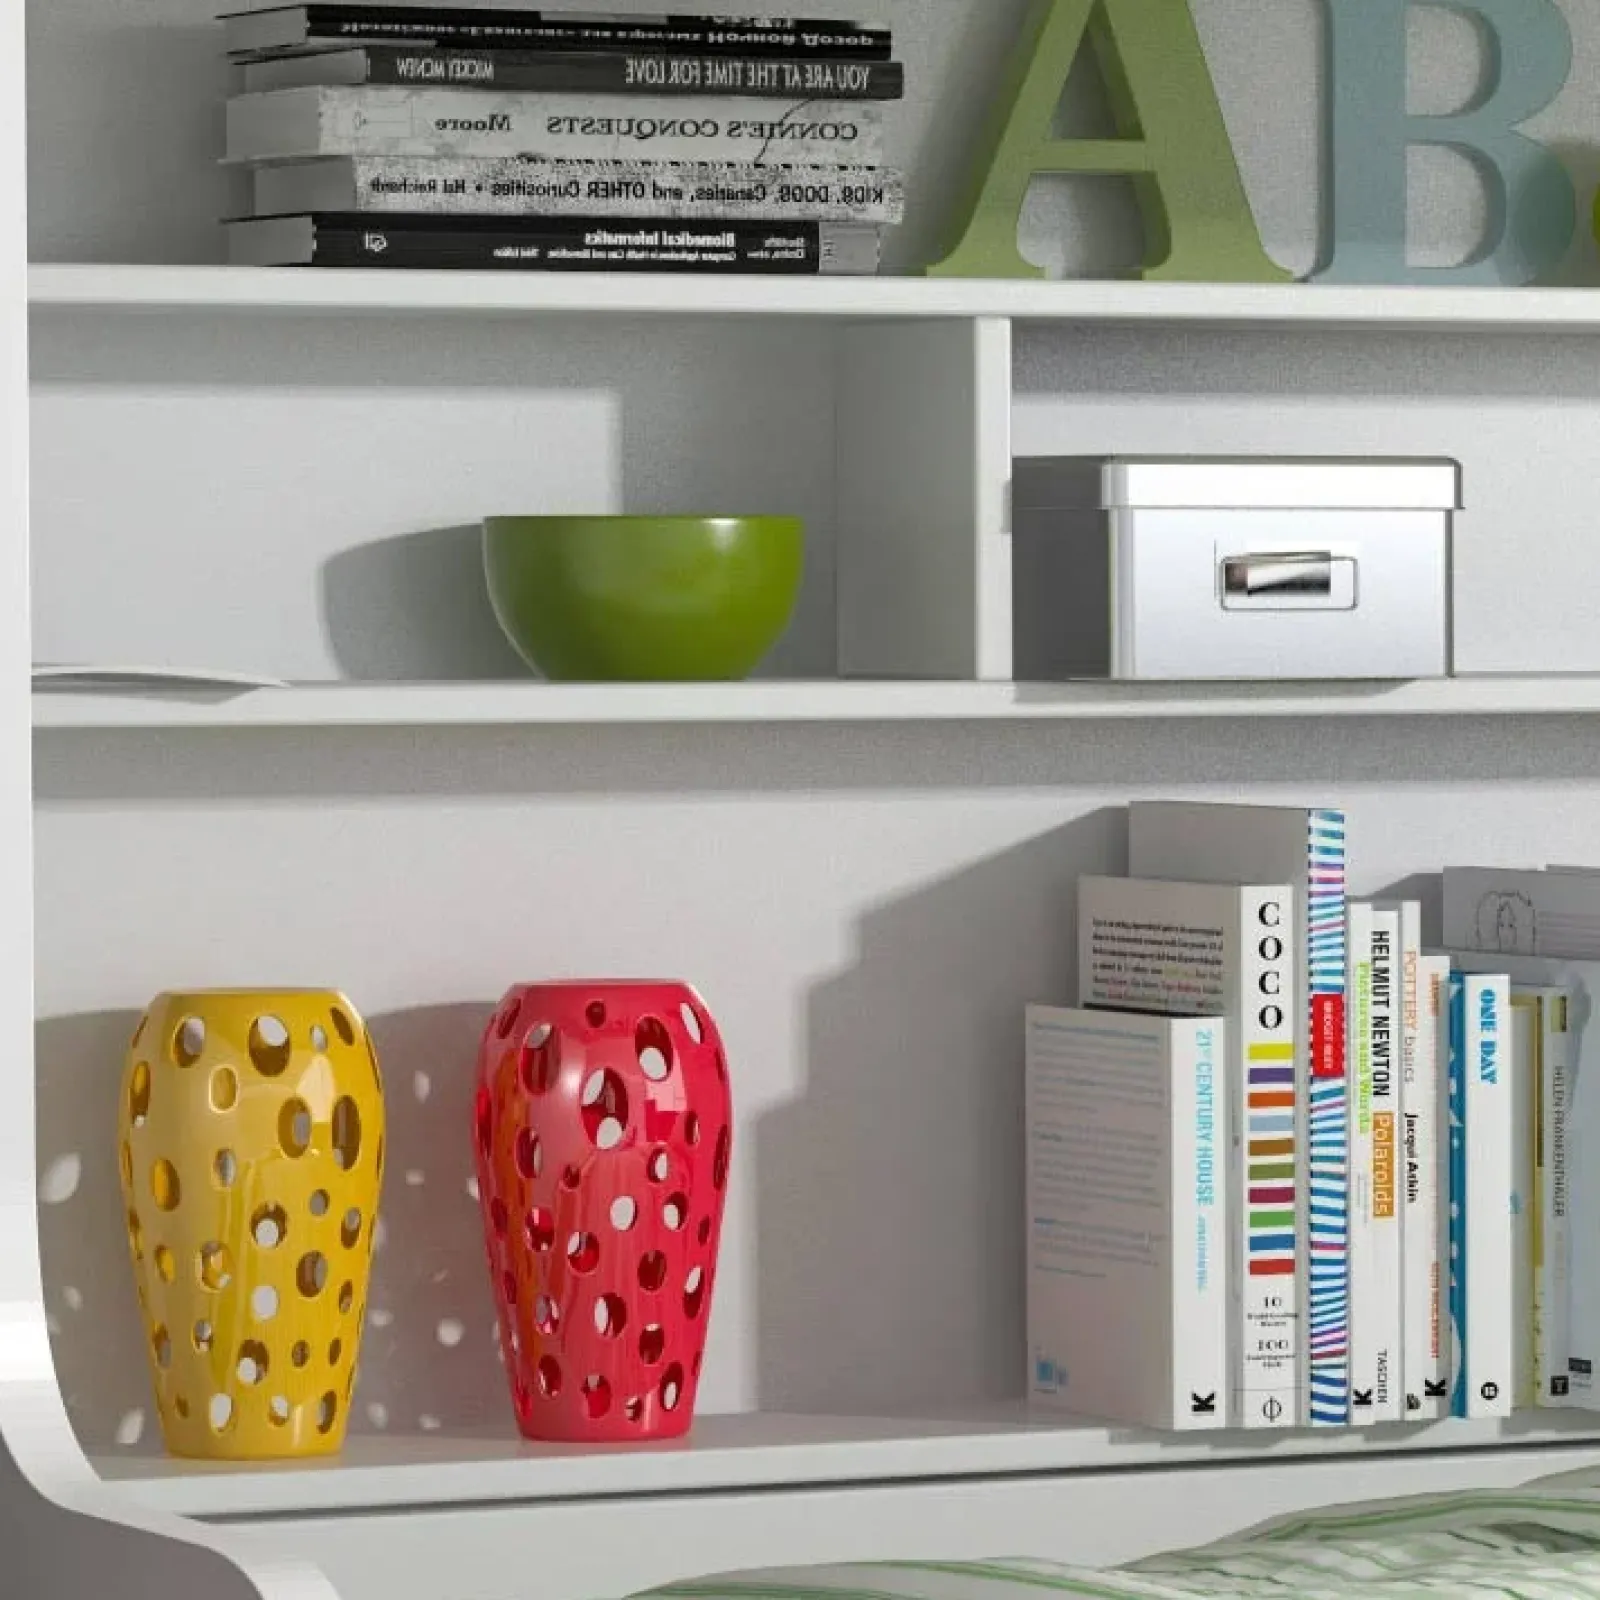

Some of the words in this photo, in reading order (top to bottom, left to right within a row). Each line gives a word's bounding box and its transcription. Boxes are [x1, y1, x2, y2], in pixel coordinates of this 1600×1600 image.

[1371, 930, 1391, 1009] HELMUT
[1403, 949, 1418, 1031] POTTERY
[1480, 989, 1497, 1033] ONE
[1371, 1016, 1391, 1097] NEWTON
[1404, 1036, 1416, 1084] basics
[1480, 1039, 1497, 1085] DAY
[1553, 1065, 1565, 1108] HELEN
[1195, 1061, 1215, 1143] CENTURY
[1195, 1145, 1215, 1207] HOUSE
[1374, 1114, 1393, 1217] Polaroids
[1377, 1350, 1388, 1404] TASCHEN
